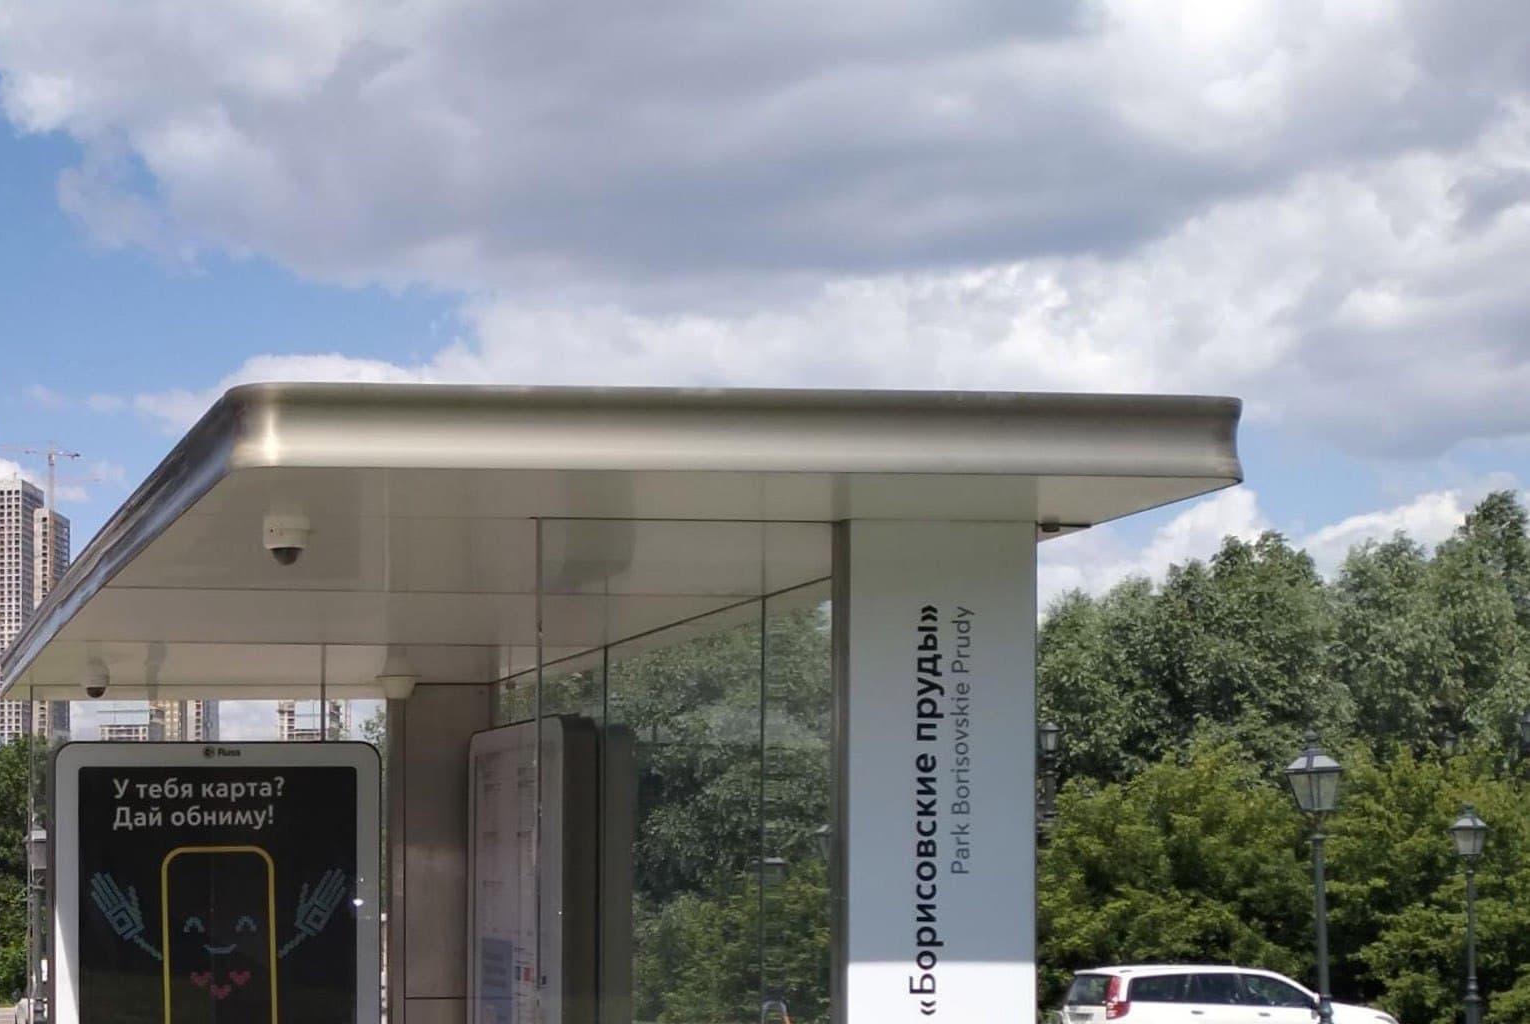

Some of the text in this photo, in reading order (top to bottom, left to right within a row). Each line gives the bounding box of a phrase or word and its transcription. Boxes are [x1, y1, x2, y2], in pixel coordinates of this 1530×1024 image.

[915, 604, 945, 742] пруды»
[949, 606, 975, 875] Park Borisovskie Prudy
[112, 776, 286, 802] У тебя карта?
[112, 804, 274, 831] Дай обниму!
[908, 752, 945, 1017] «Борисовские
